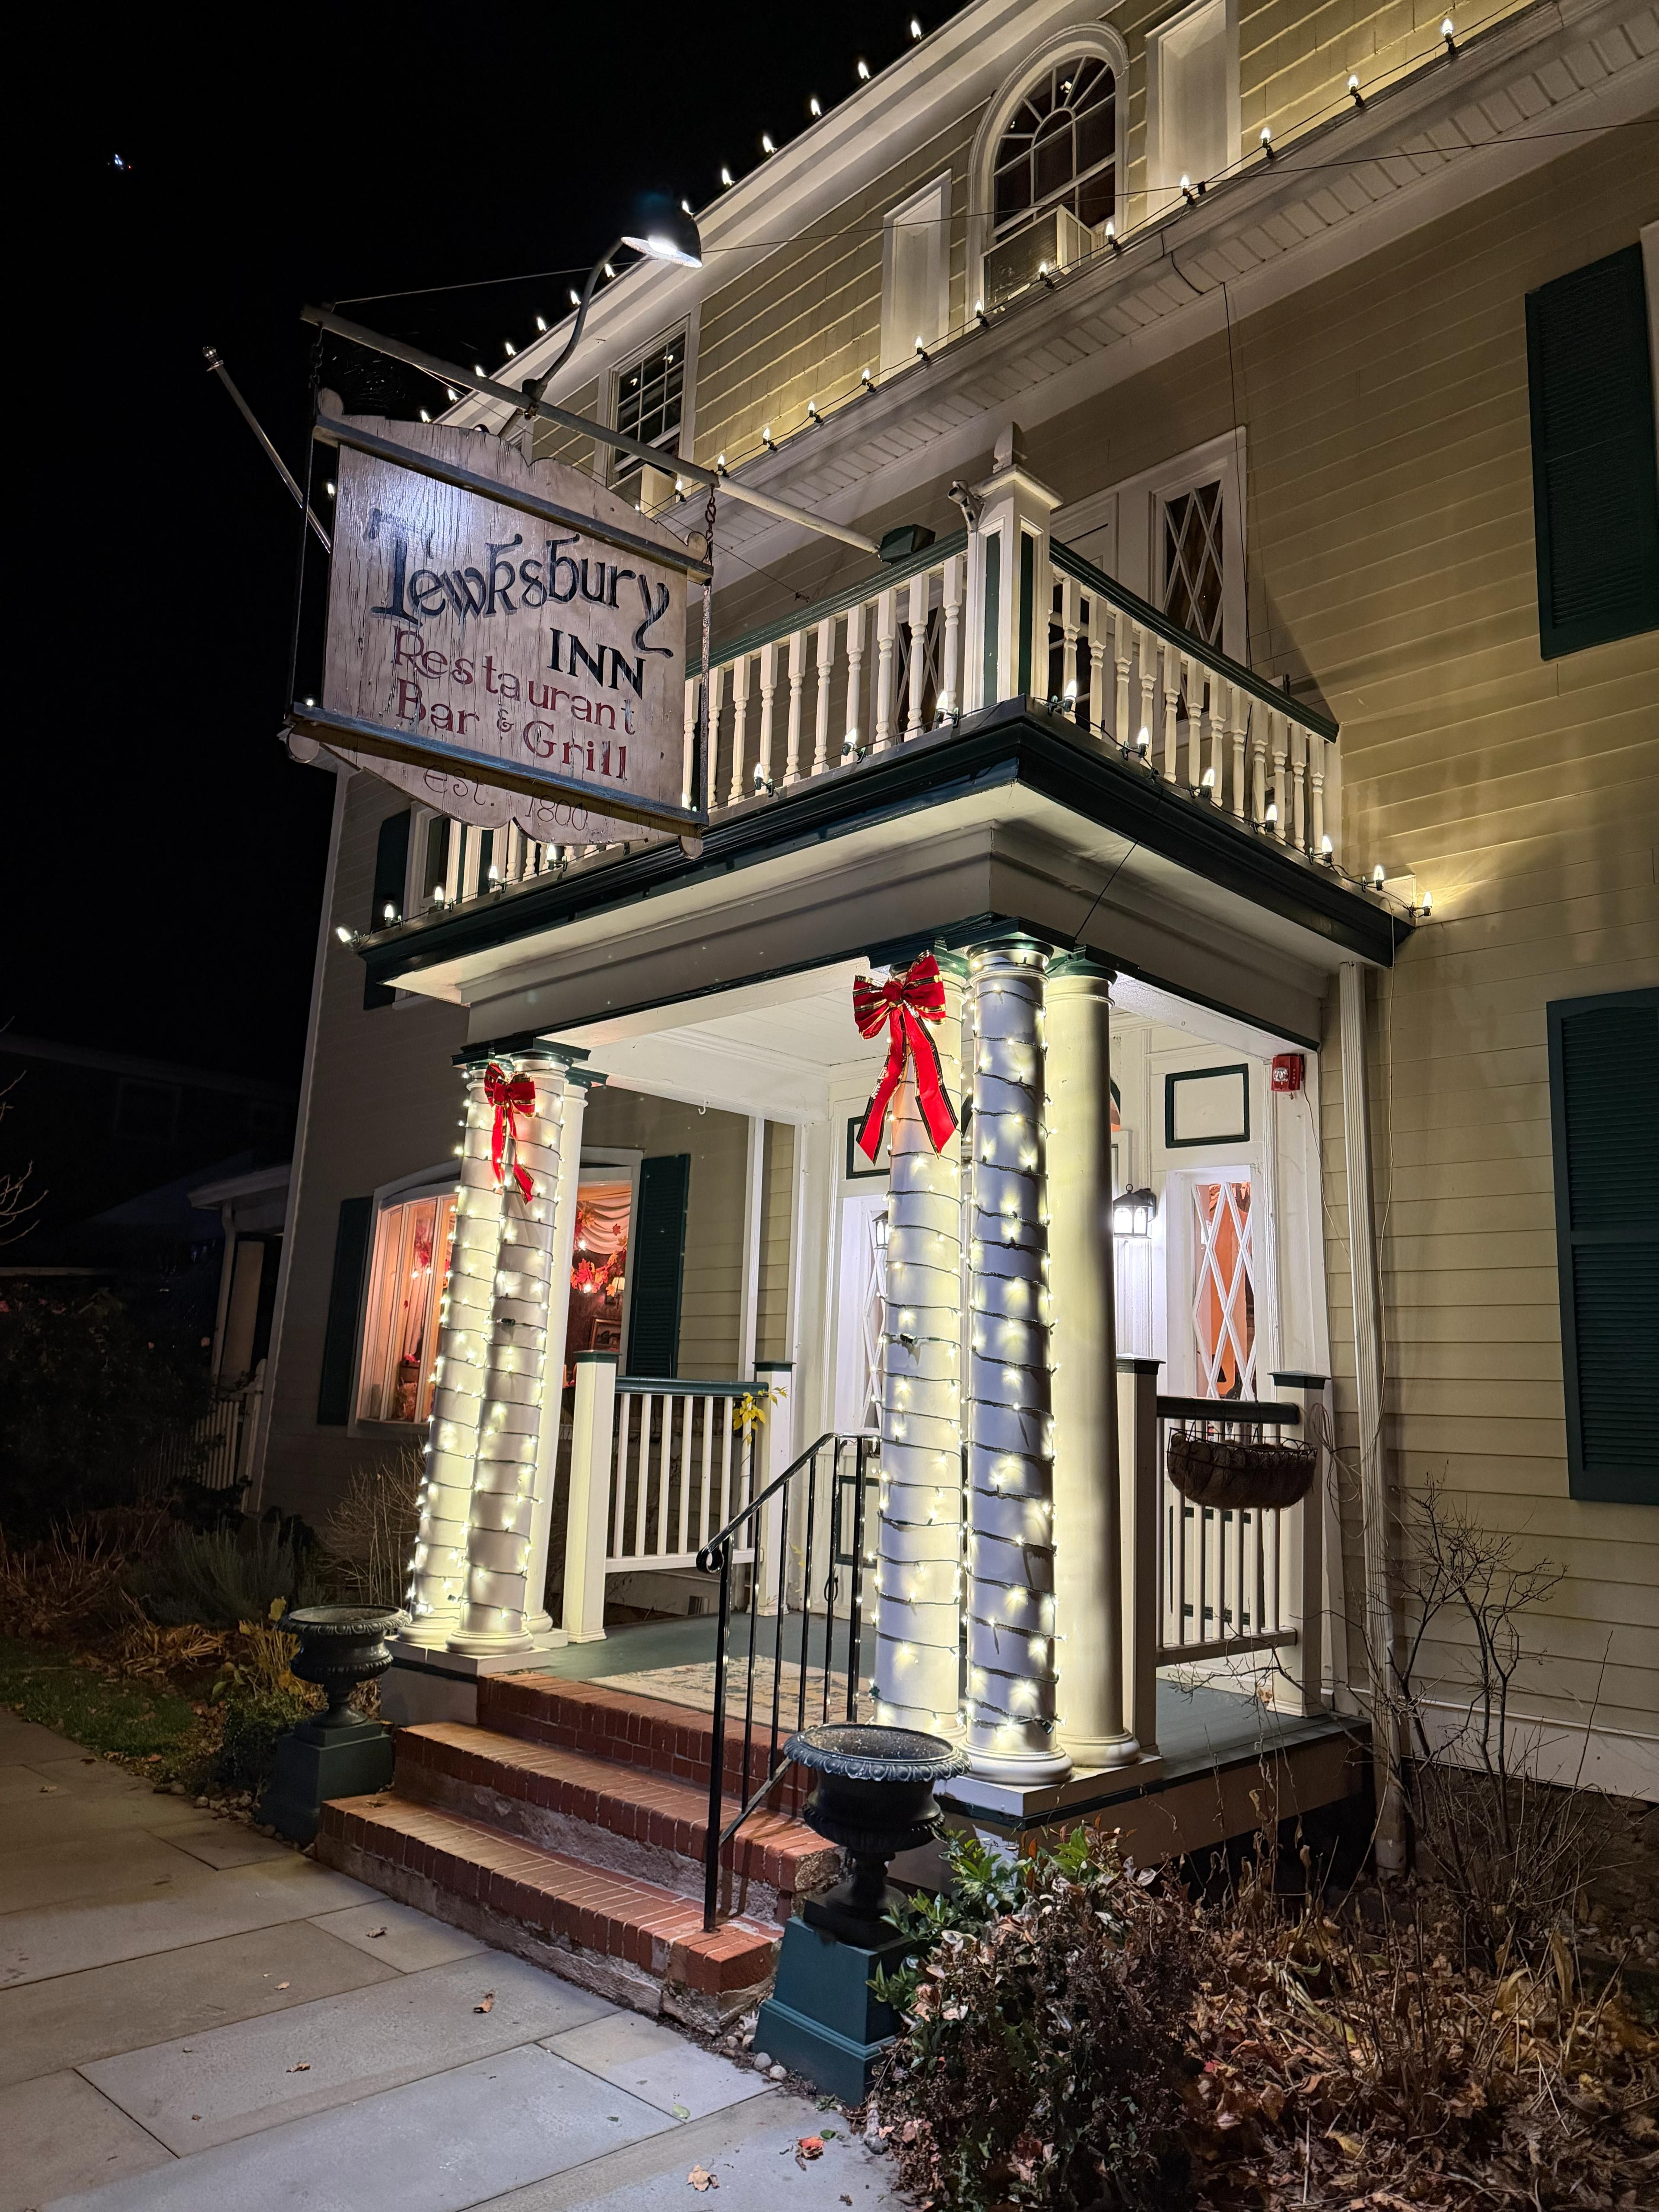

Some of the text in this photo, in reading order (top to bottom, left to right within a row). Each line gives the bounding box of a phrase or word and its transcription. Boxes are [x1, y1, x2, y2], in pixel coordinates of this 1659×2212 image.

[367, 509, 673, 657] Tewksbury
[393, 625, 636, 735] Restaurant
[547, 628, 645, 699] INN
[395, 678, 628, 781] Bar & Grill
[525, 795, 588, 831] 1800
